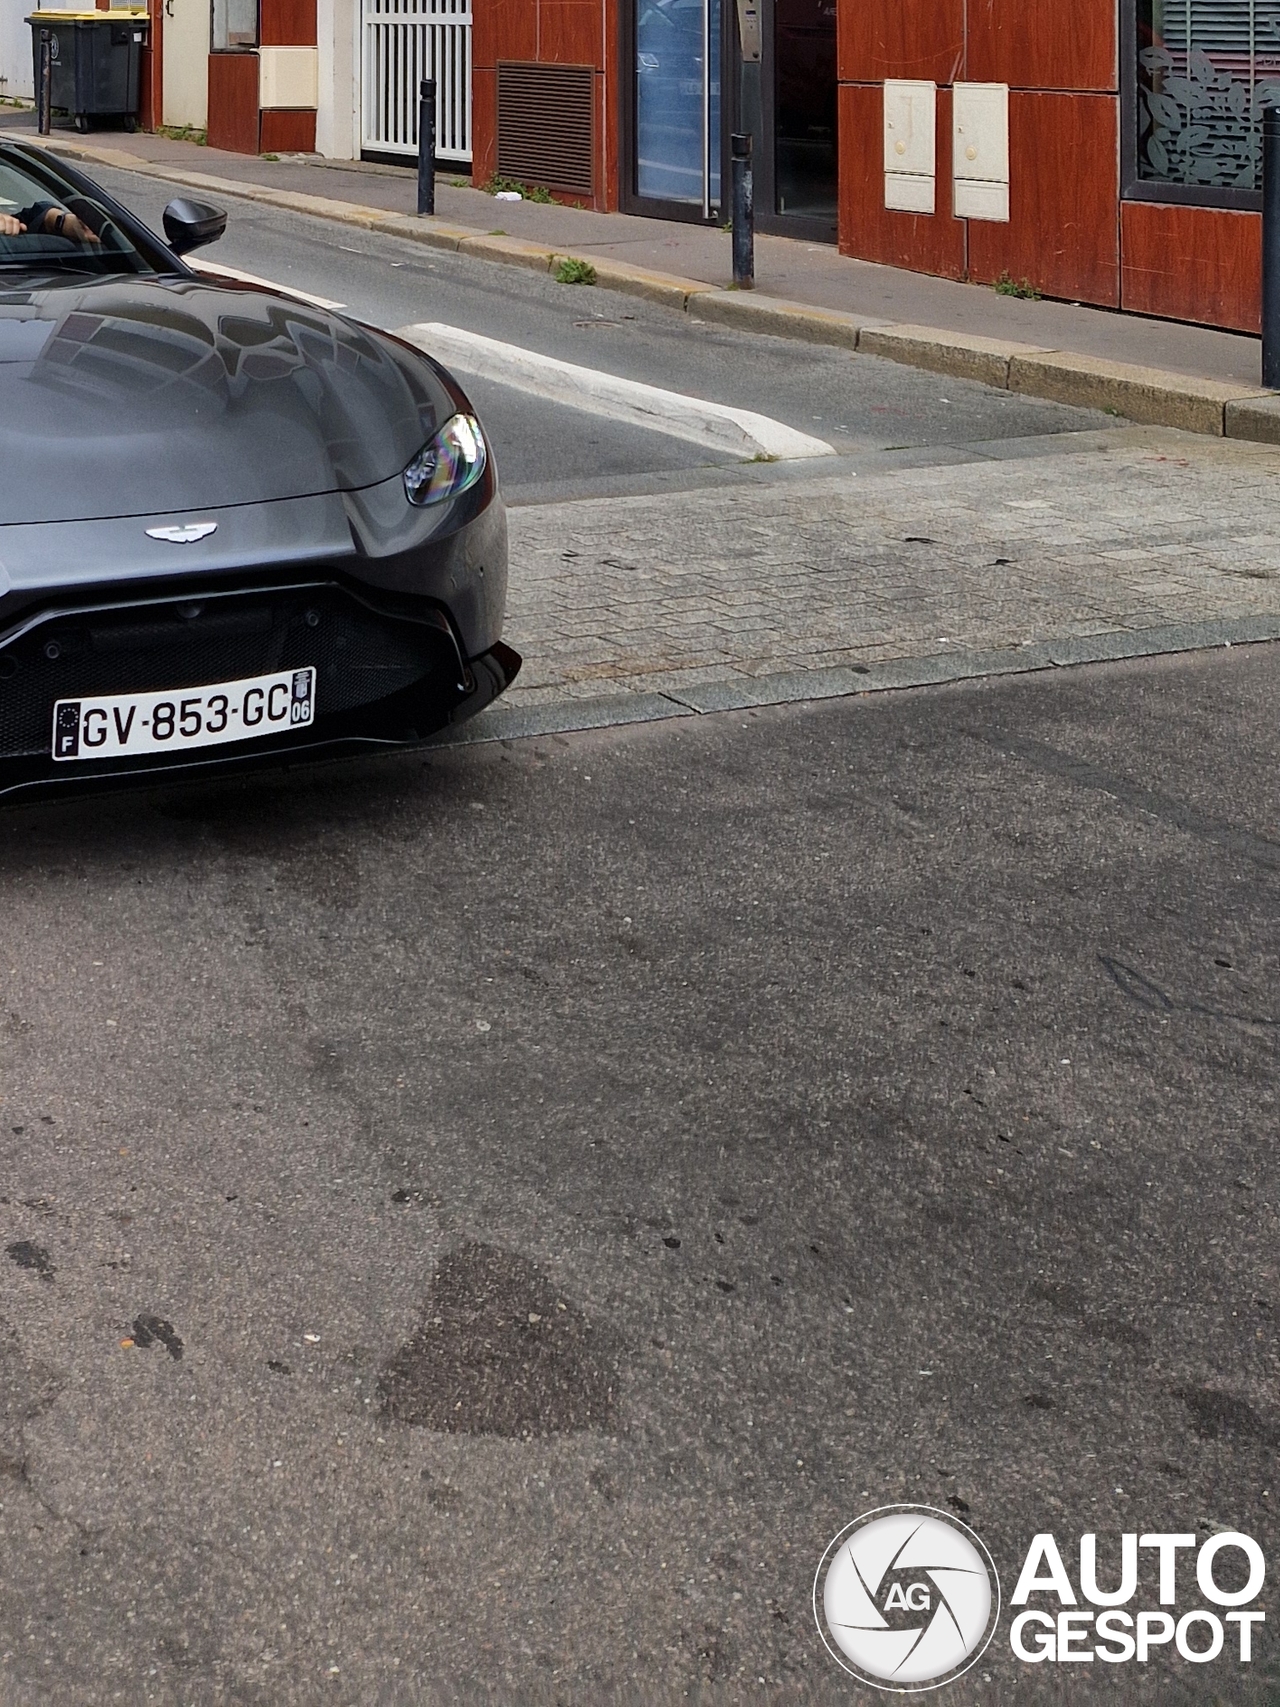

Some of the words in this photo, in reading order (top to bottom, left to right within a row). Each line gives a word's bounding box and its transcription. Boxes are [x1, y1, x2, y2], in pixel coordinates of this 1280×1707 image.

[83, 683, 289, 748] GV-853-GC
[292, 702, 310, 722] 06
[62, 736, 74, 752] F
